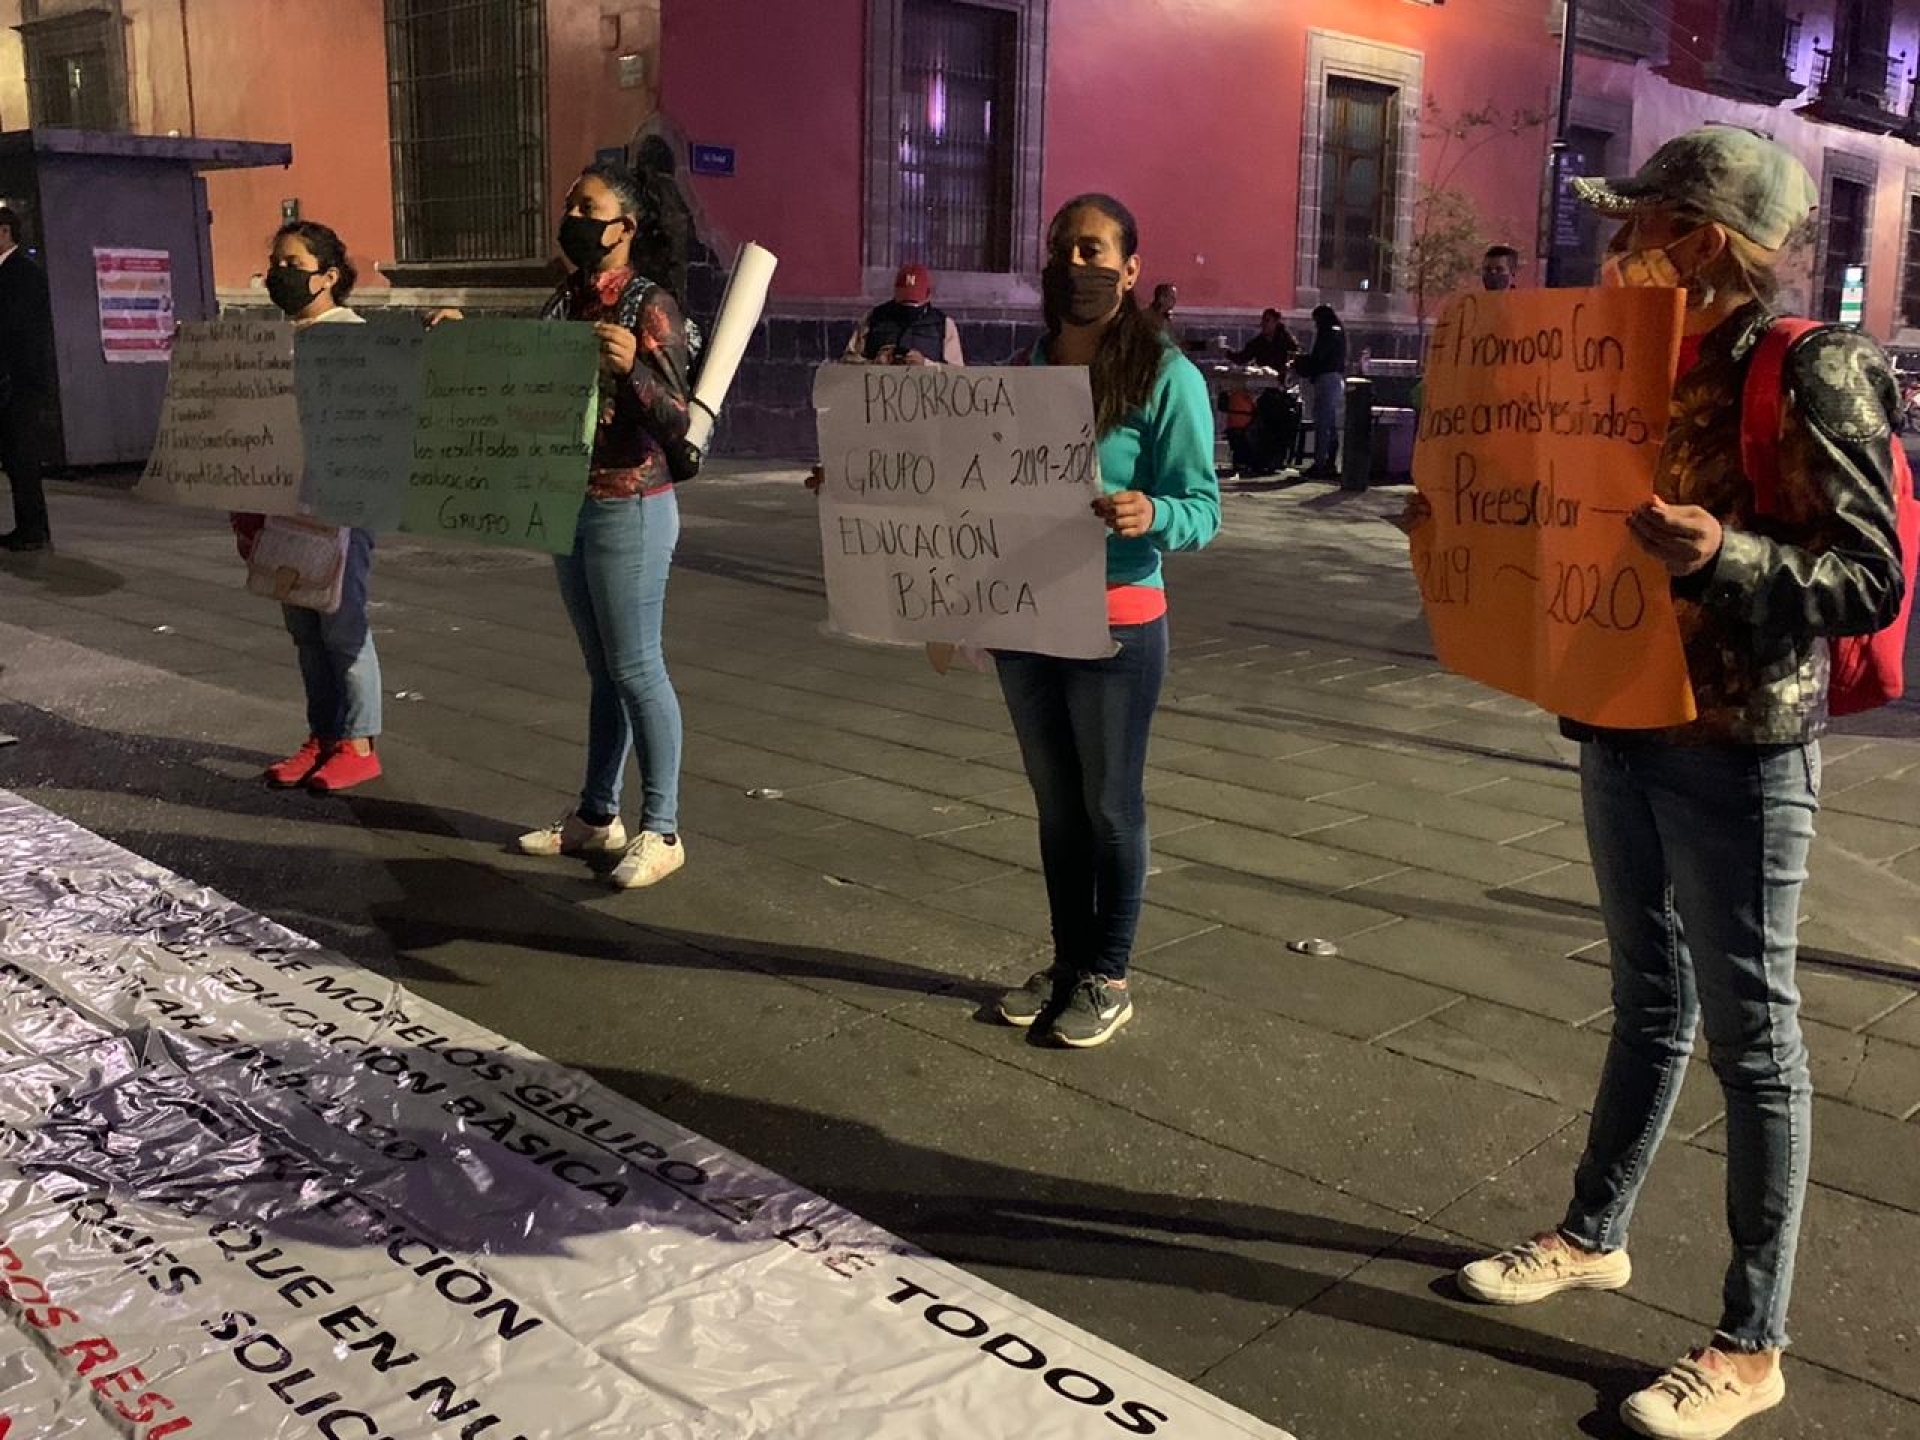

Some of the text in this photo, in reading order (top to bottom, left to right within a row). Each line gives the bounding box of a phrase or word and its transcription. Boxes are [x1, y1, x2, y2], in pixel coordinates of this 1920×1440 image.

[864, 367, 1015, 424] PRÓRROGA
[845, 450, 936, 495] GRUPO
[839, 509, 1001, 560] EDUCACIÓN
[892, 566, 1039, 621] BÁSICA
[1548, 560, 1646, 631] 2020
[514, 1082, 709, 1187] GRUPO
[885, 1276, 1169, 1437] TODOS
[207, 1218, 336, 1309] QUE
[318, 1303, 420, 1373] EN
[200, 1311, 395, 1440] SOLIC
